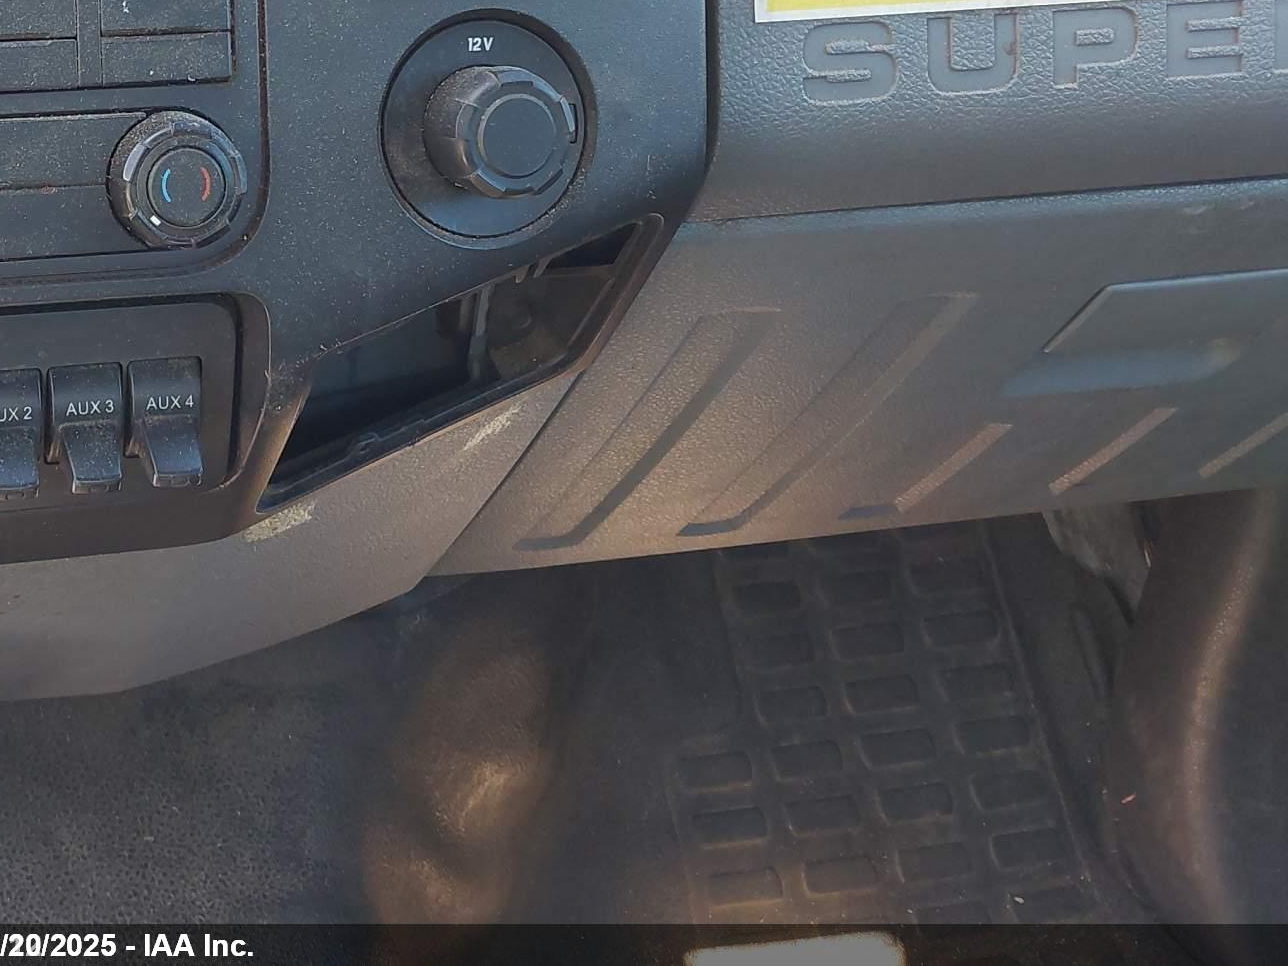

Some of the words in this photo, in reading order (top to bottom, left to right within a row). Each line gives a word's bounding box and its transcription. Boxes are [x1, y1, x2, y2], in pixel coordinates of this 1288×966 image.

[467, 36, 493, 53] 12V
[65, 400, 101, 417] AUX
[104, 399, 114, 414] 3
[145, 395, 181, 410] AUX
[184, 394, 194, 409] 4
[23, 406, 33, 421] 2
